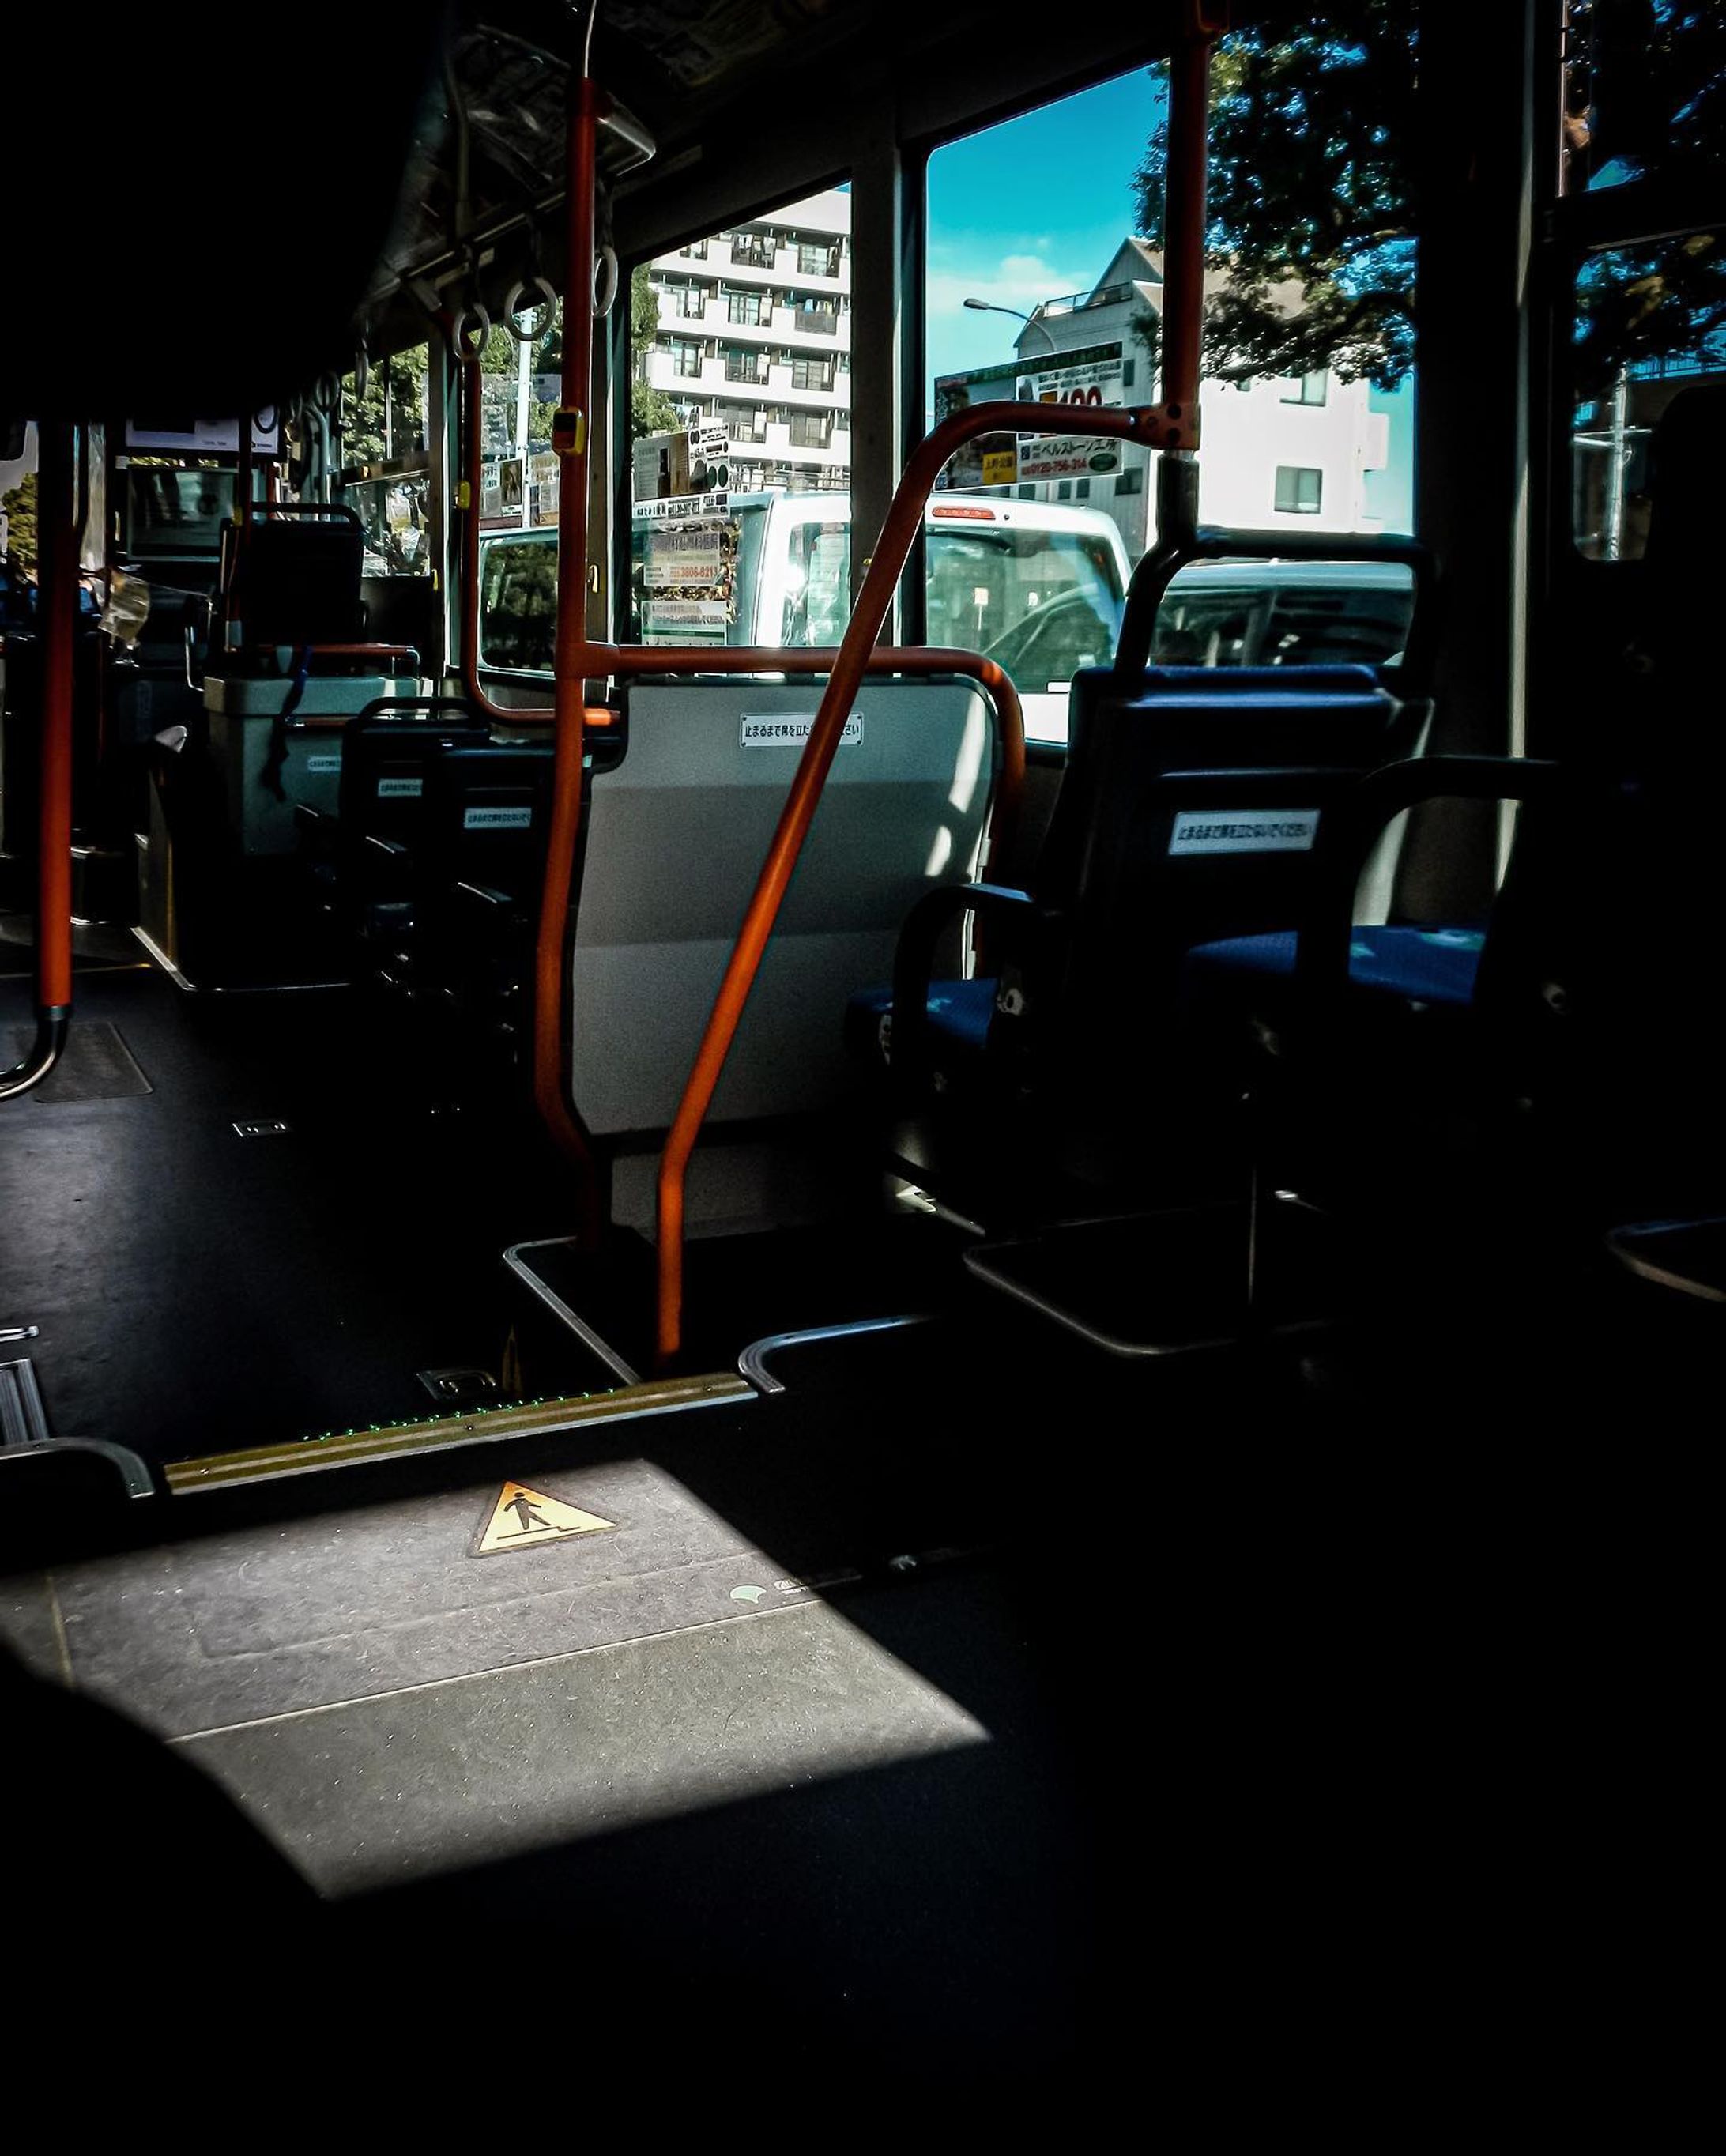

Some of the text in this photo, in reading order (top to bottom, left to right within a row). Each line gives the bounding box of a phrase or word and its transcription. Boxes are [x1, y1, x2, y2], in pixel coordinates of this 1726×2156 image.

[745, 724, 860, 737] 止まるまで席を立たさい
